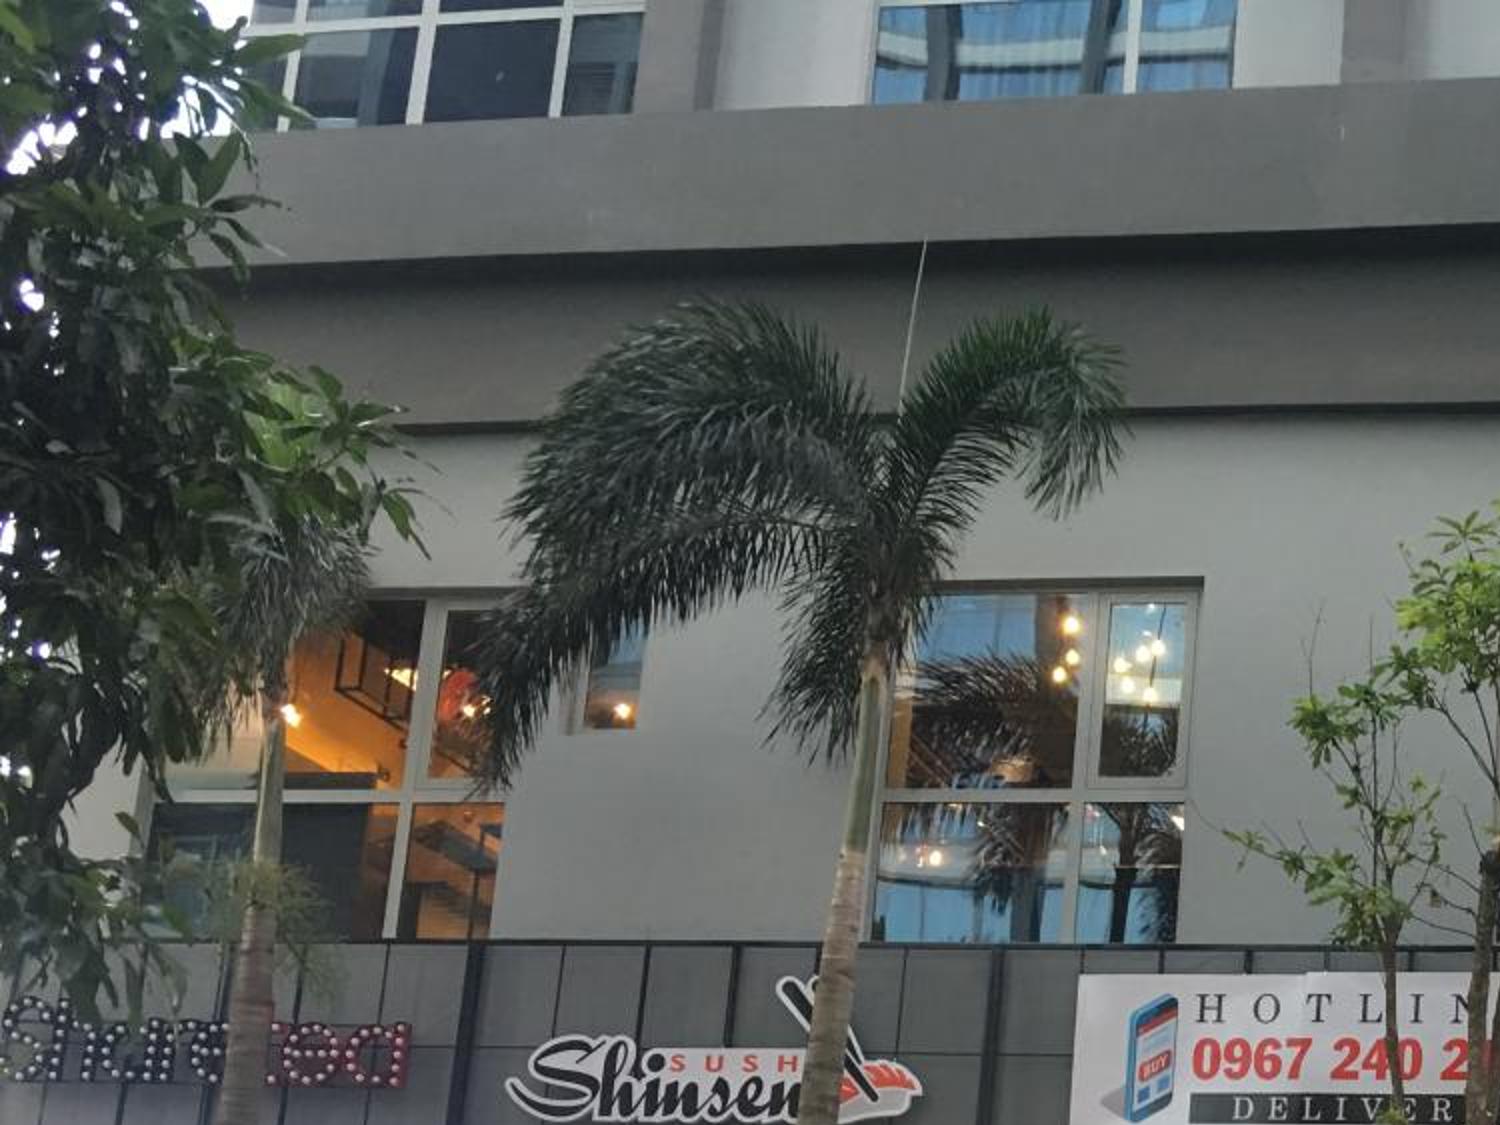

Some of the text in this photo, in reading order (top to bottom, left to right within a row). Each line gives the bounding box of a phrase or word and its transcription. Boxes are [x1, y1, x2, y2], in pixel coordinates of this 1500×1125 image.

[670, 1055, 800, 1073] SUSH
[1140, 1053, 1169, 1079] BUY
[1193, 1037, 1313, 1081] 0967
[1330, 1037, 1423, 1081] 240
[505, 1034, 803, 1123] Shinsen
[1232, 1096, 1454, 1122] DELIVER
